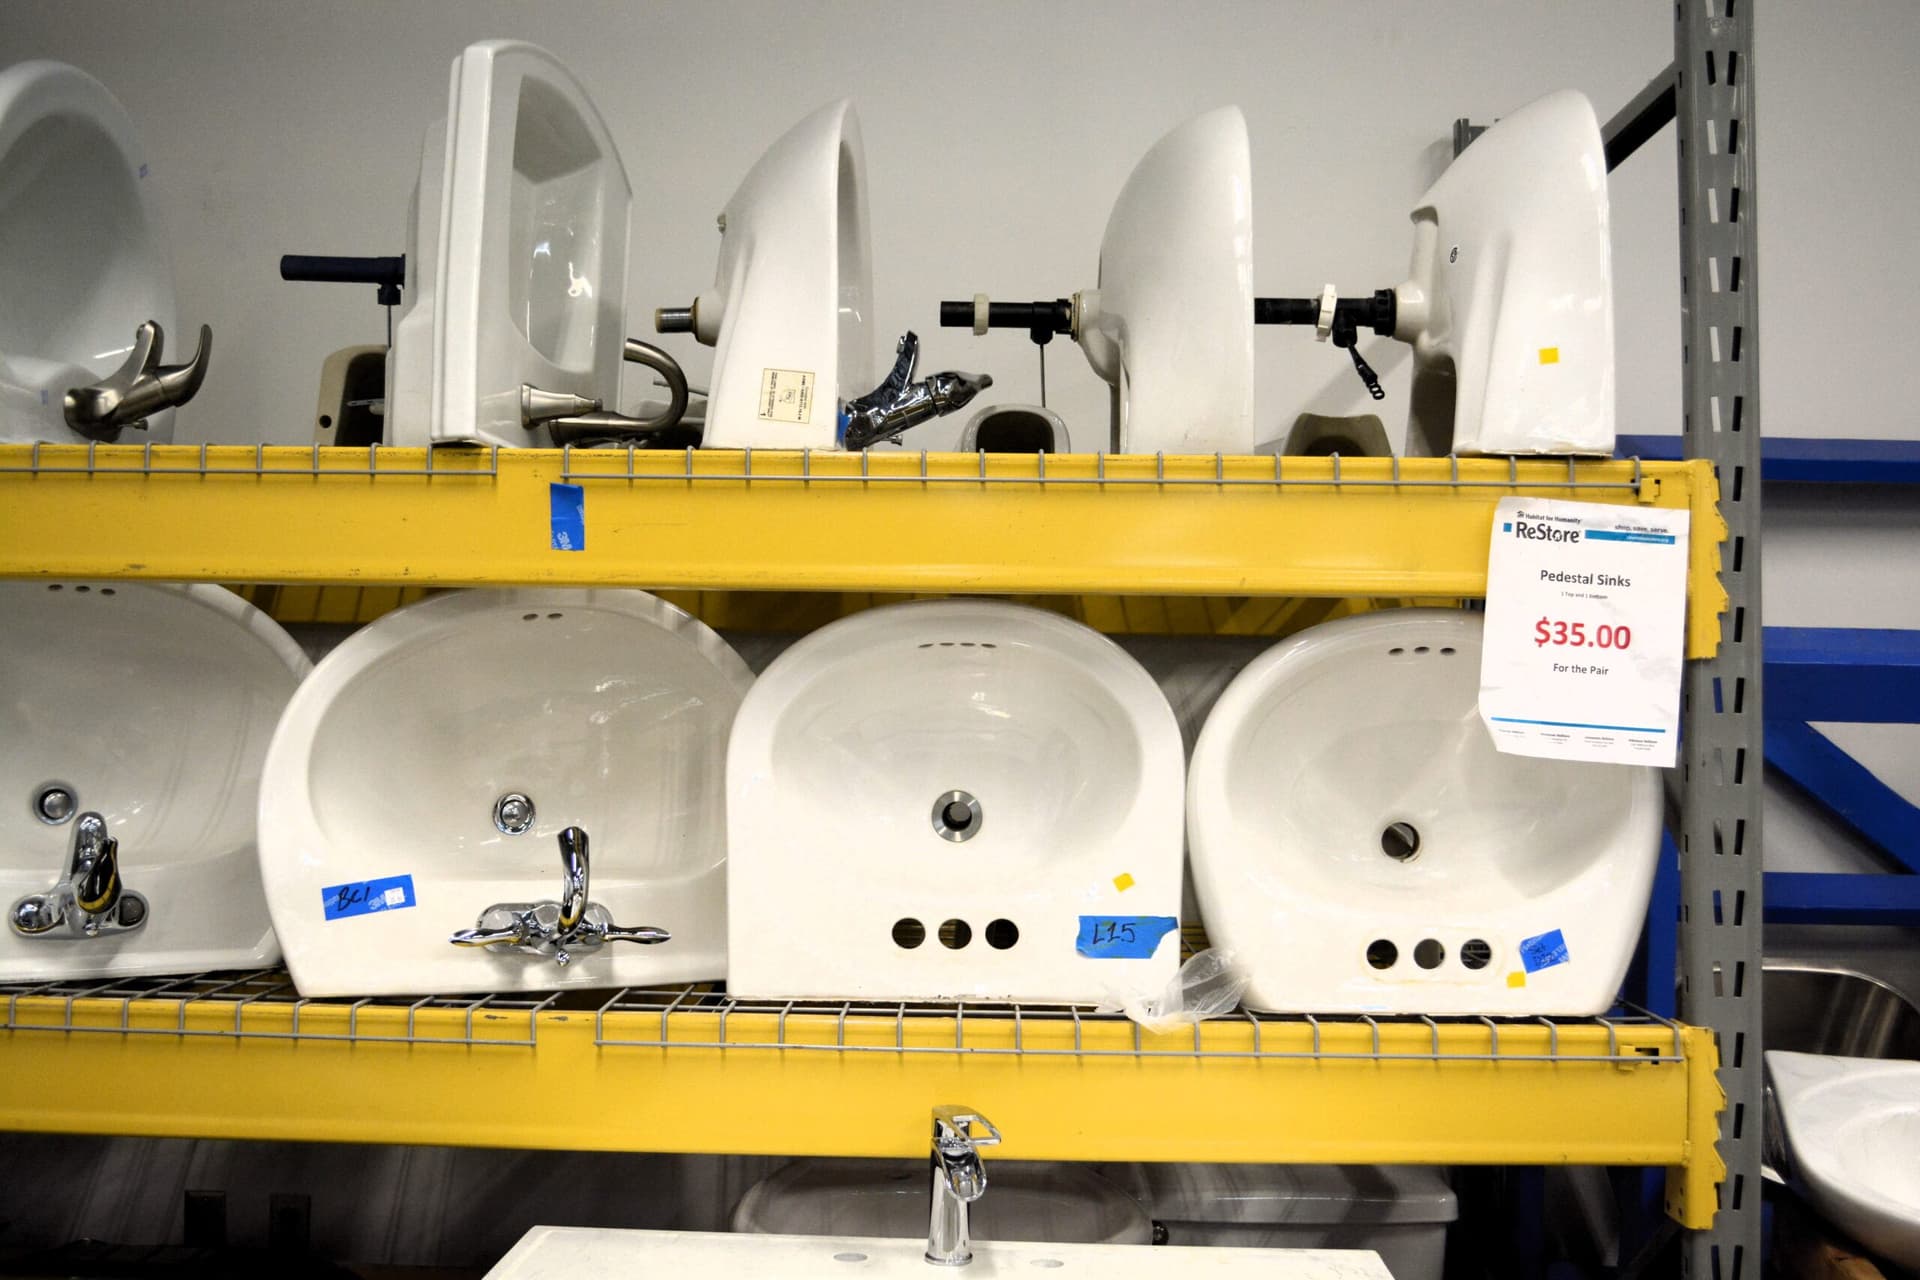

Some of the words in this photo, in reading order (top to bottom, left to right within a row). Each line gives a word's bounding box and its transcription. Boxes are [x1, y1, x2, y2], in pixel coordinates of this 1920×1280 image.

[1526, 513, 1545, 521] Habitat
[1555, 516, 1581, 525] Humanity
[1516, 521, 1580, 543] ReStore
[1540, 569, 1594, 585] Pedestal
[1597, 574, 1631, 587] Sinks
[1534, 616, 1631, 649] $35.00
[1553, 663, 1569, 672] For
[1571, 665, 1587, 674] the
[1590, 666, 1608, 675] Pair
